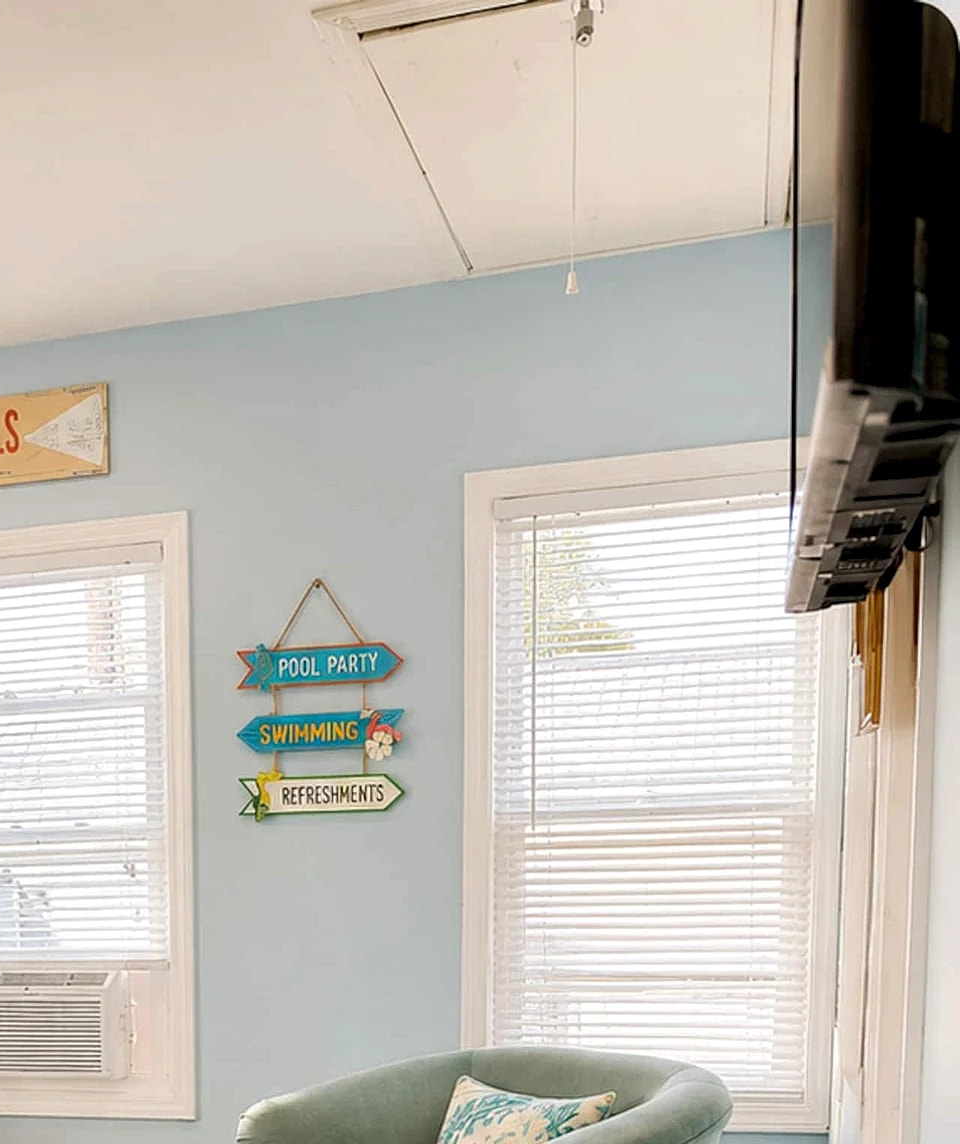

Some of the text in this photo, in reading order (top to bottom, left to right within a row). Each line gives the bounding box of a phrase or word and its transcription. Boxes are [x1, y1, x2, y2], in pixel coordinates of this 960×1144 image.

[278, 651, 379, 679] POOL PARTY
[259, 720, 359, 745] SWIMMING
[281, 783, 385, 806] REFRESHMENTS
